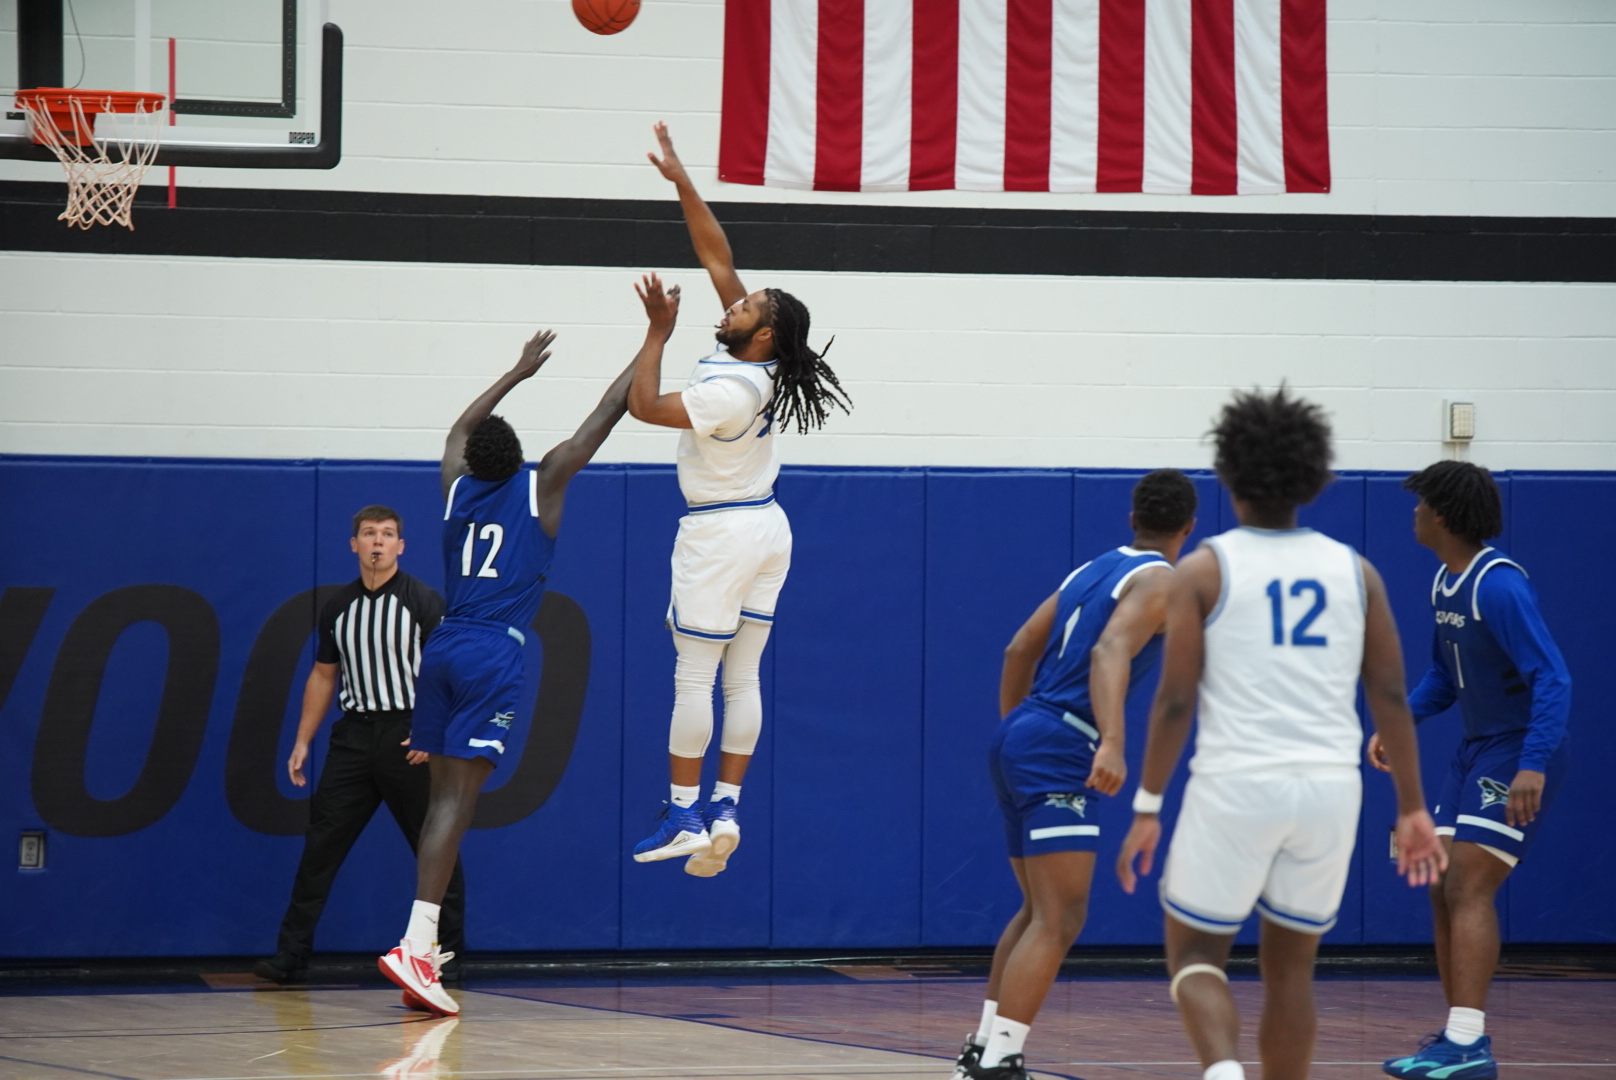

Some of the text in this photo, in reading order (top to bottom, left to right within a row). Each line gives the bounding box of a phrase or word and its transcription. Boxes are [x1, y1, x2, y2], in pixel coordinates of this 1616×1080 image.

[289, 132, 315, 145] DRAPER
[461, 522, 503, 578] 12
[1266, 579, 1327, 646] 12
